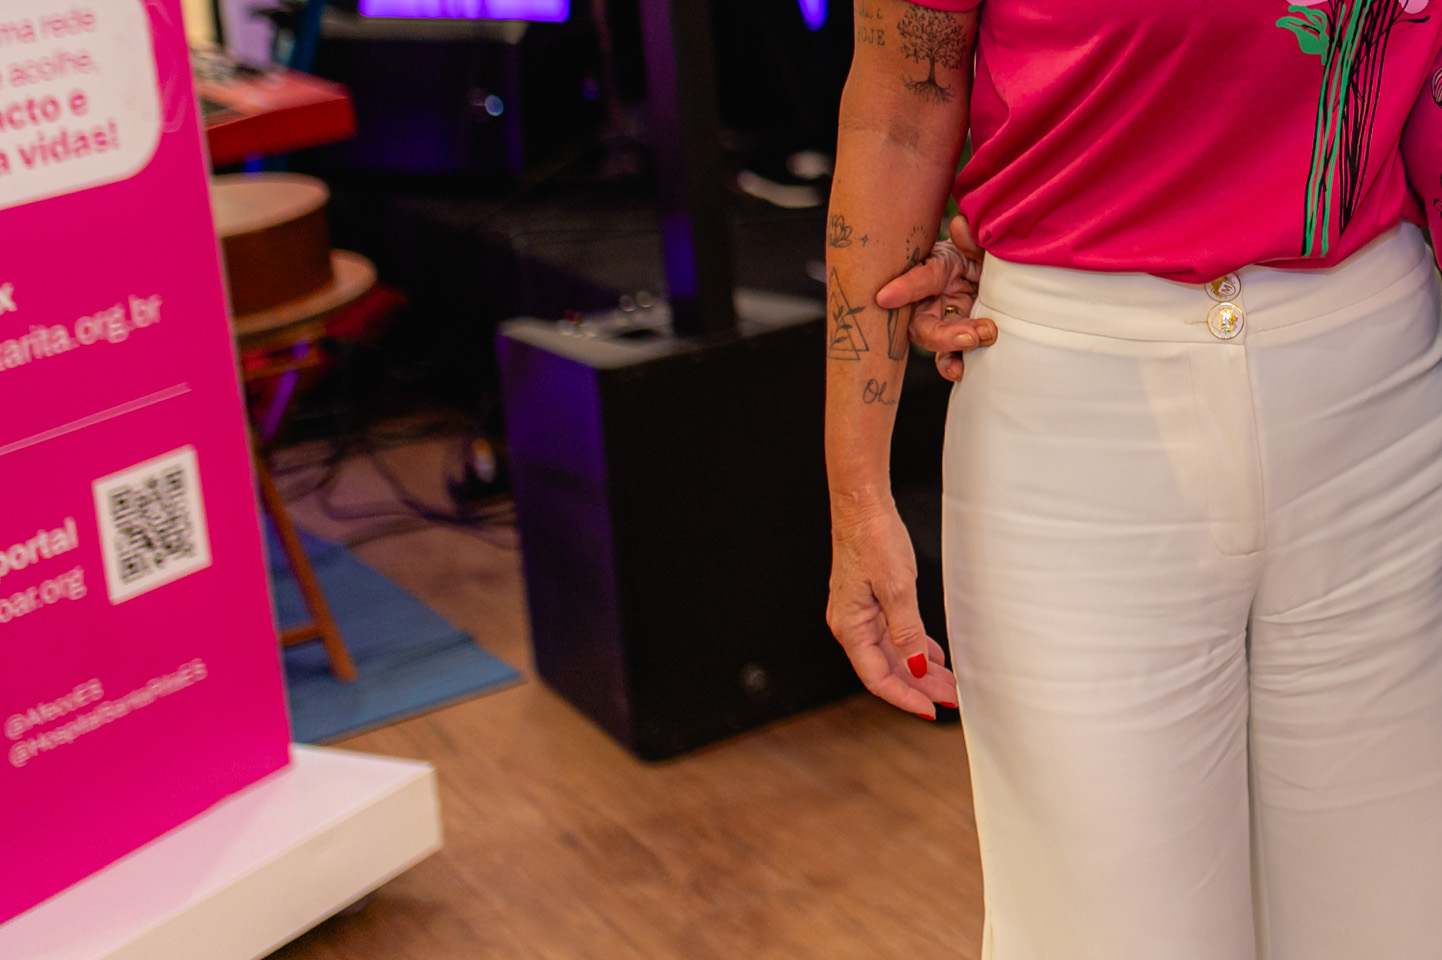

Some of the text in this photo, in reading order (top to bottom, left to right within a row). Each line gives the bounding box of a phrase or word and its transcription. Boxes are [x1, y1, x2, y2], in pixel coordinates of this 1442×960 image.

[0, 88, 88, 139] cto e
[17, 117, 120, 170] vidas!
